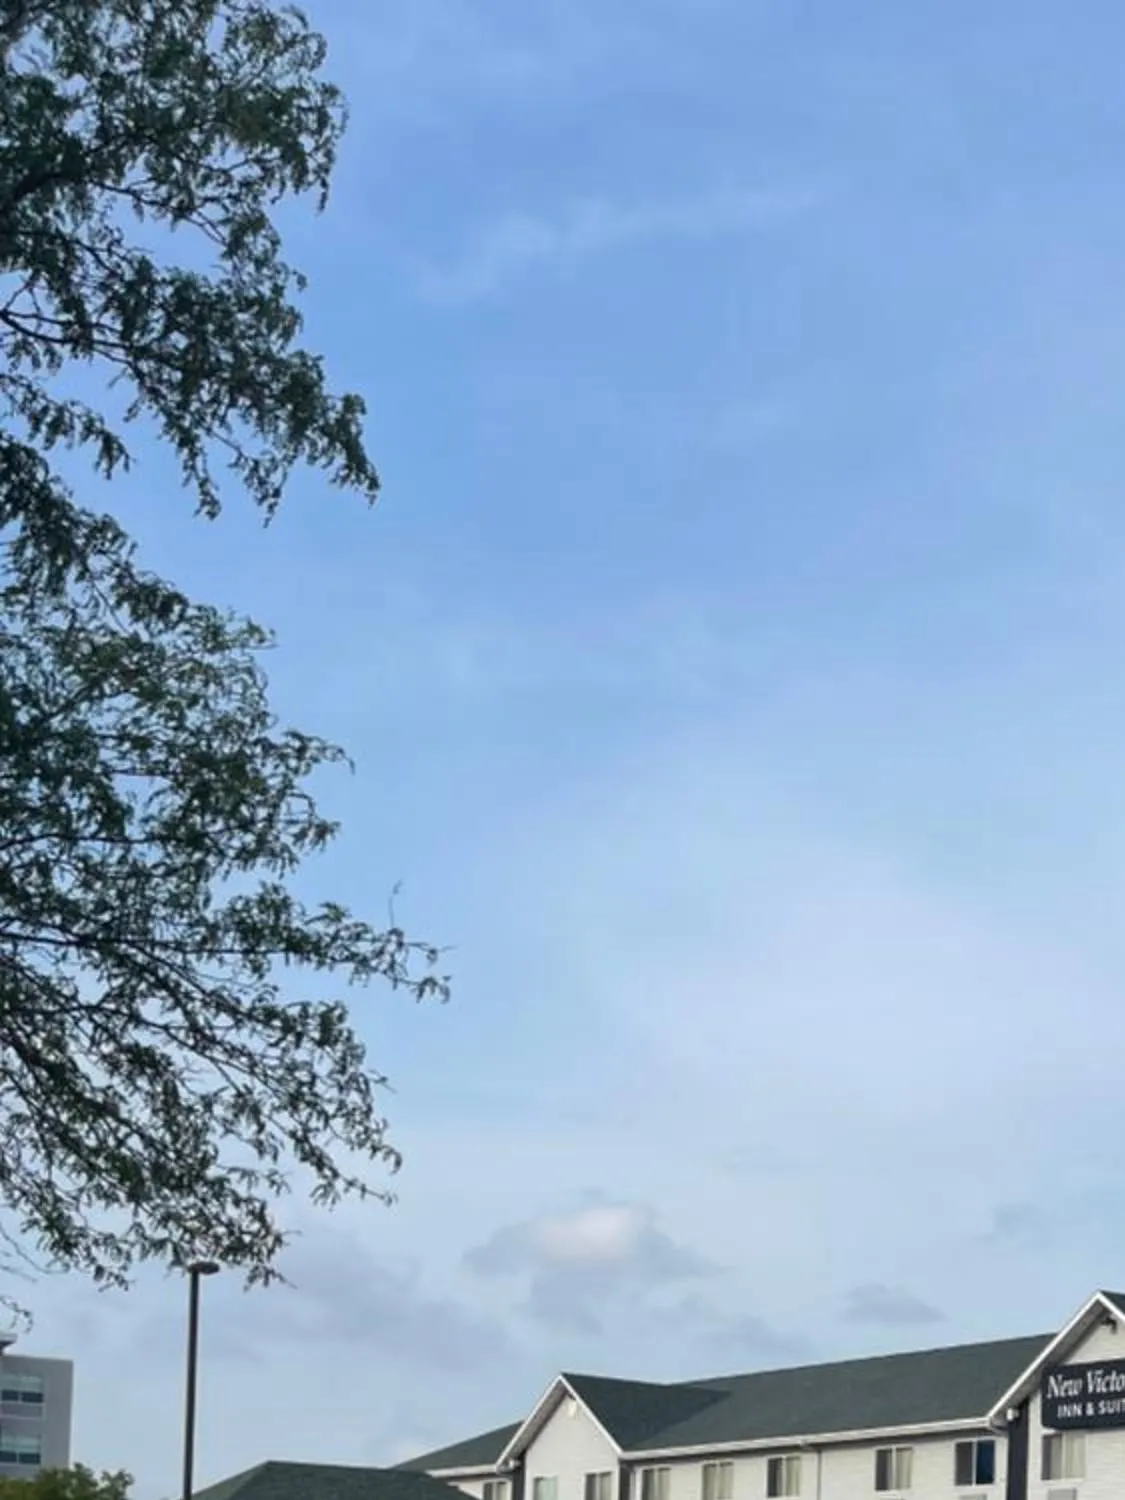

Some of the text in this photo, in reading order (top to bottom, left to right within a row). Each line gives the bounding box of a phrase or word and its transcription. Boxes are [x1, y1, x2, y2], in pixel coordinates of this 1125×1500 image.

[1047, 1374, 1083, 1399] New
[1057, 1403, 1083, 1419] INN
[1085, 1401, 1095, 1417] &
